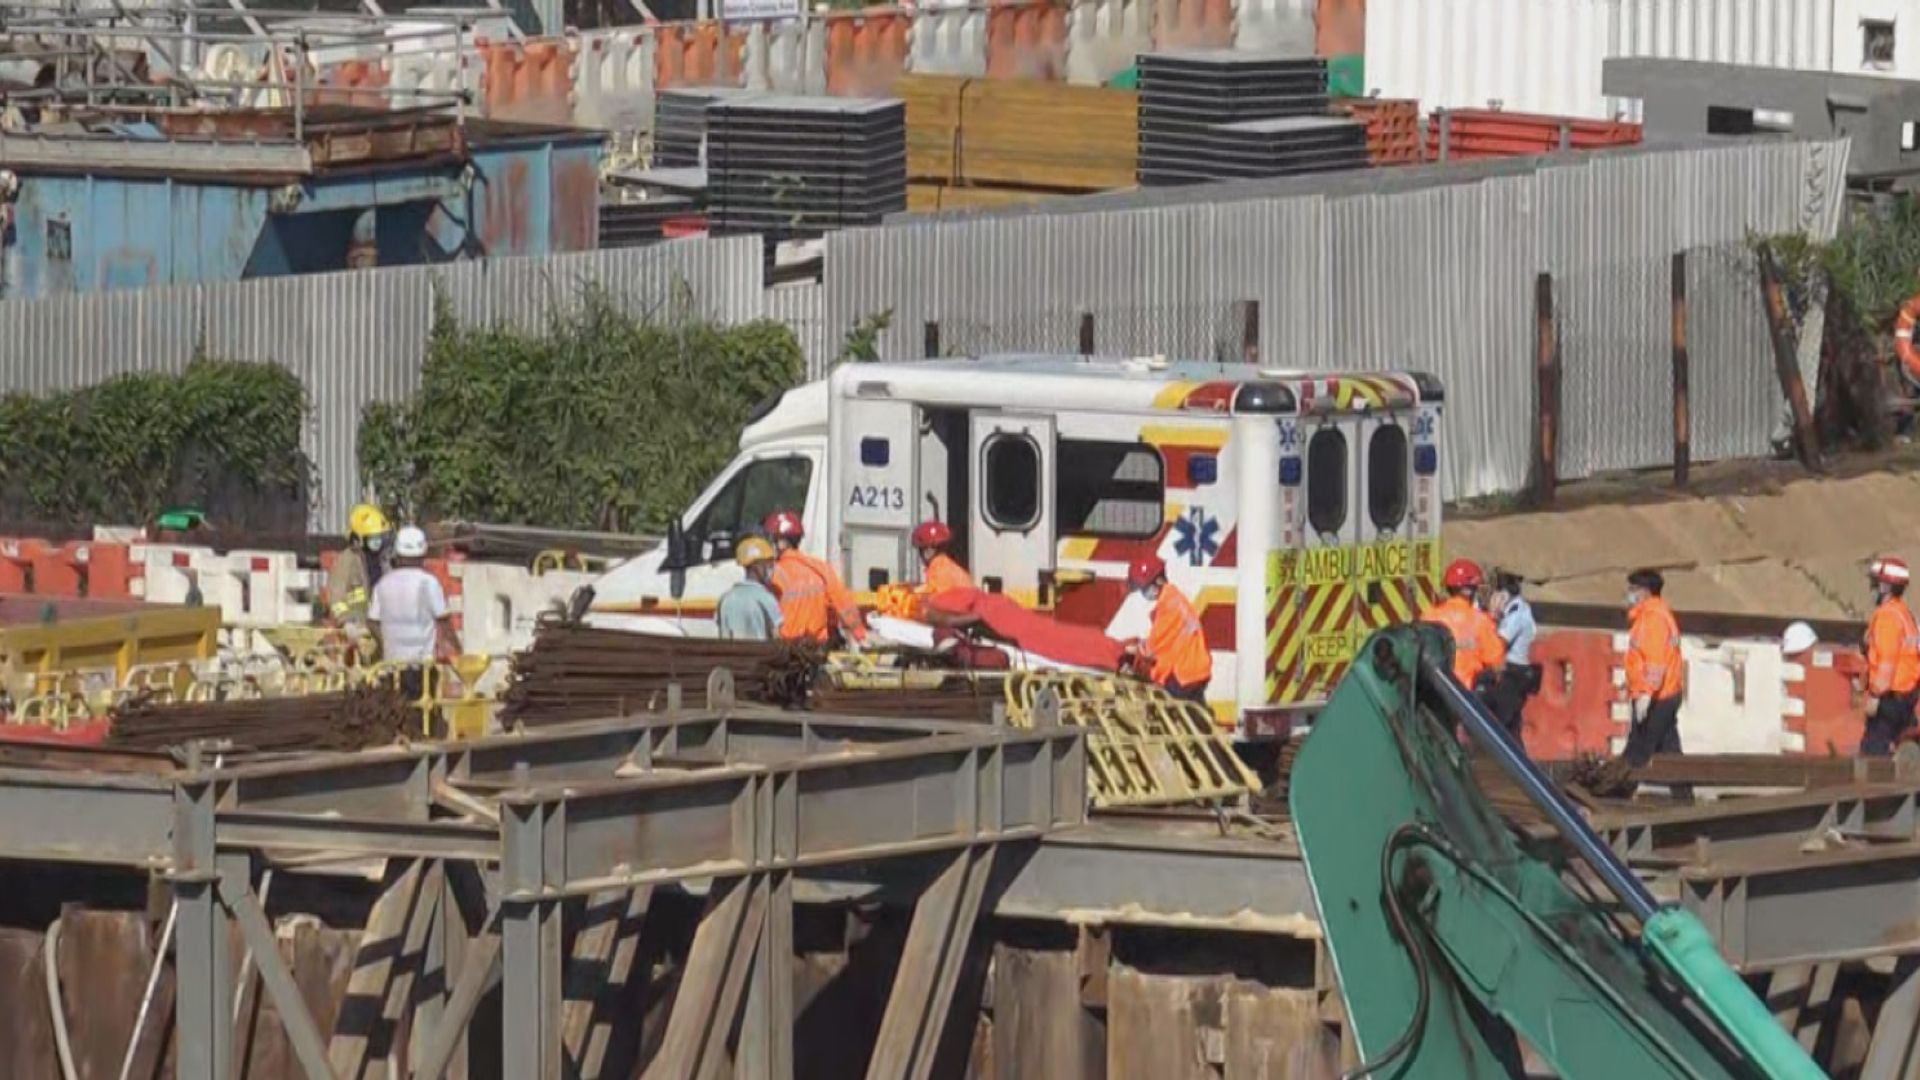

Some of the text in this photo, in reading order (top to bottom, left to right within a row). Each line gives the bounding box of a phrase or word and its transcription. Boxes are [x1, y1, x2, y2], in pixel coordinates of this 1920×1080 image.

[850, 486, 903, 509] A213
[1304, 544, 1407, 580] AMBULANCE
[1306, 636, 1347, 658] KEEP
